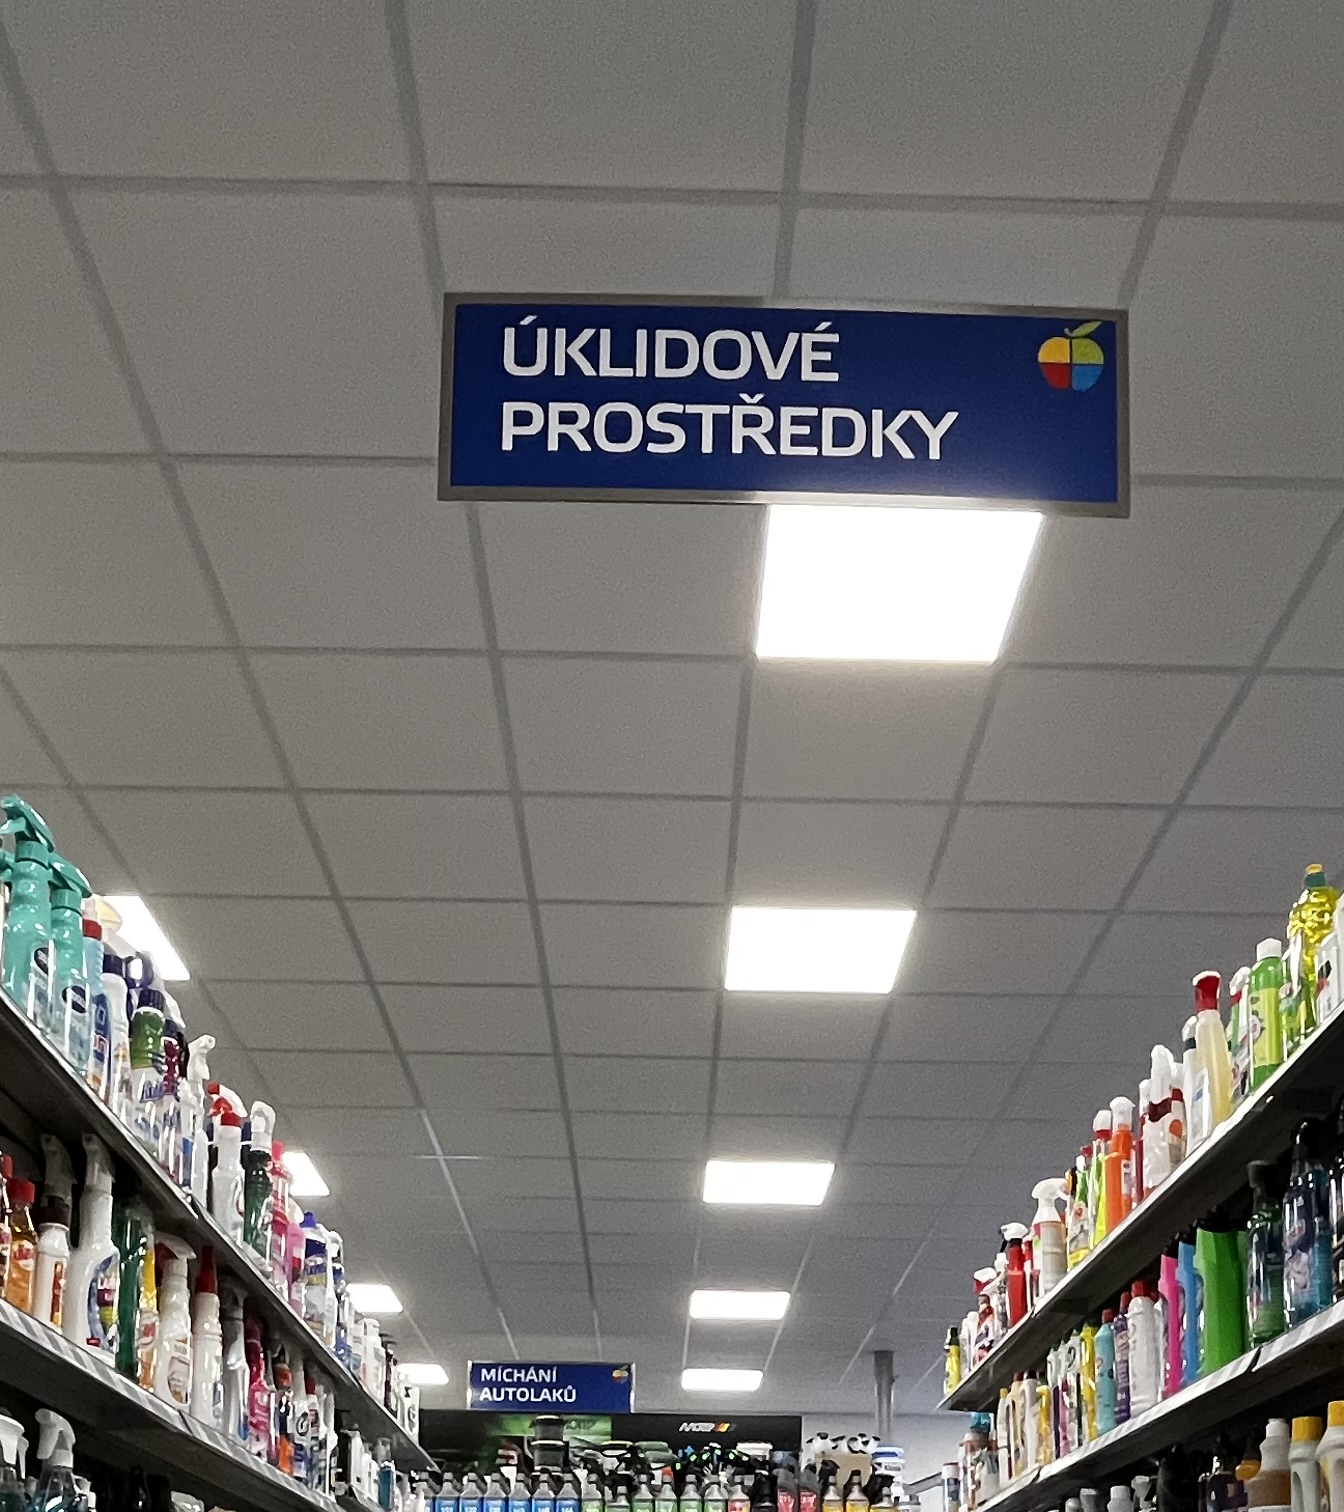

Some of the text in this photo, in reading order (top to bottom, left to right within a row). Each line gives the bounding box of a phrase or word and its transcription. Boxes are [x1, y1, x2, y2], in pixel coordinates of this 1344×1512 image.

[501, 315, 840, 383] ÚKLIDOVÉ
[500, 395, 959, 461] PROSTŘEDKY
[478, 1385, 578, 1404] AUTOLAKŮ
[480, 1365, 558, 1384] MÍCHÁNÍ
